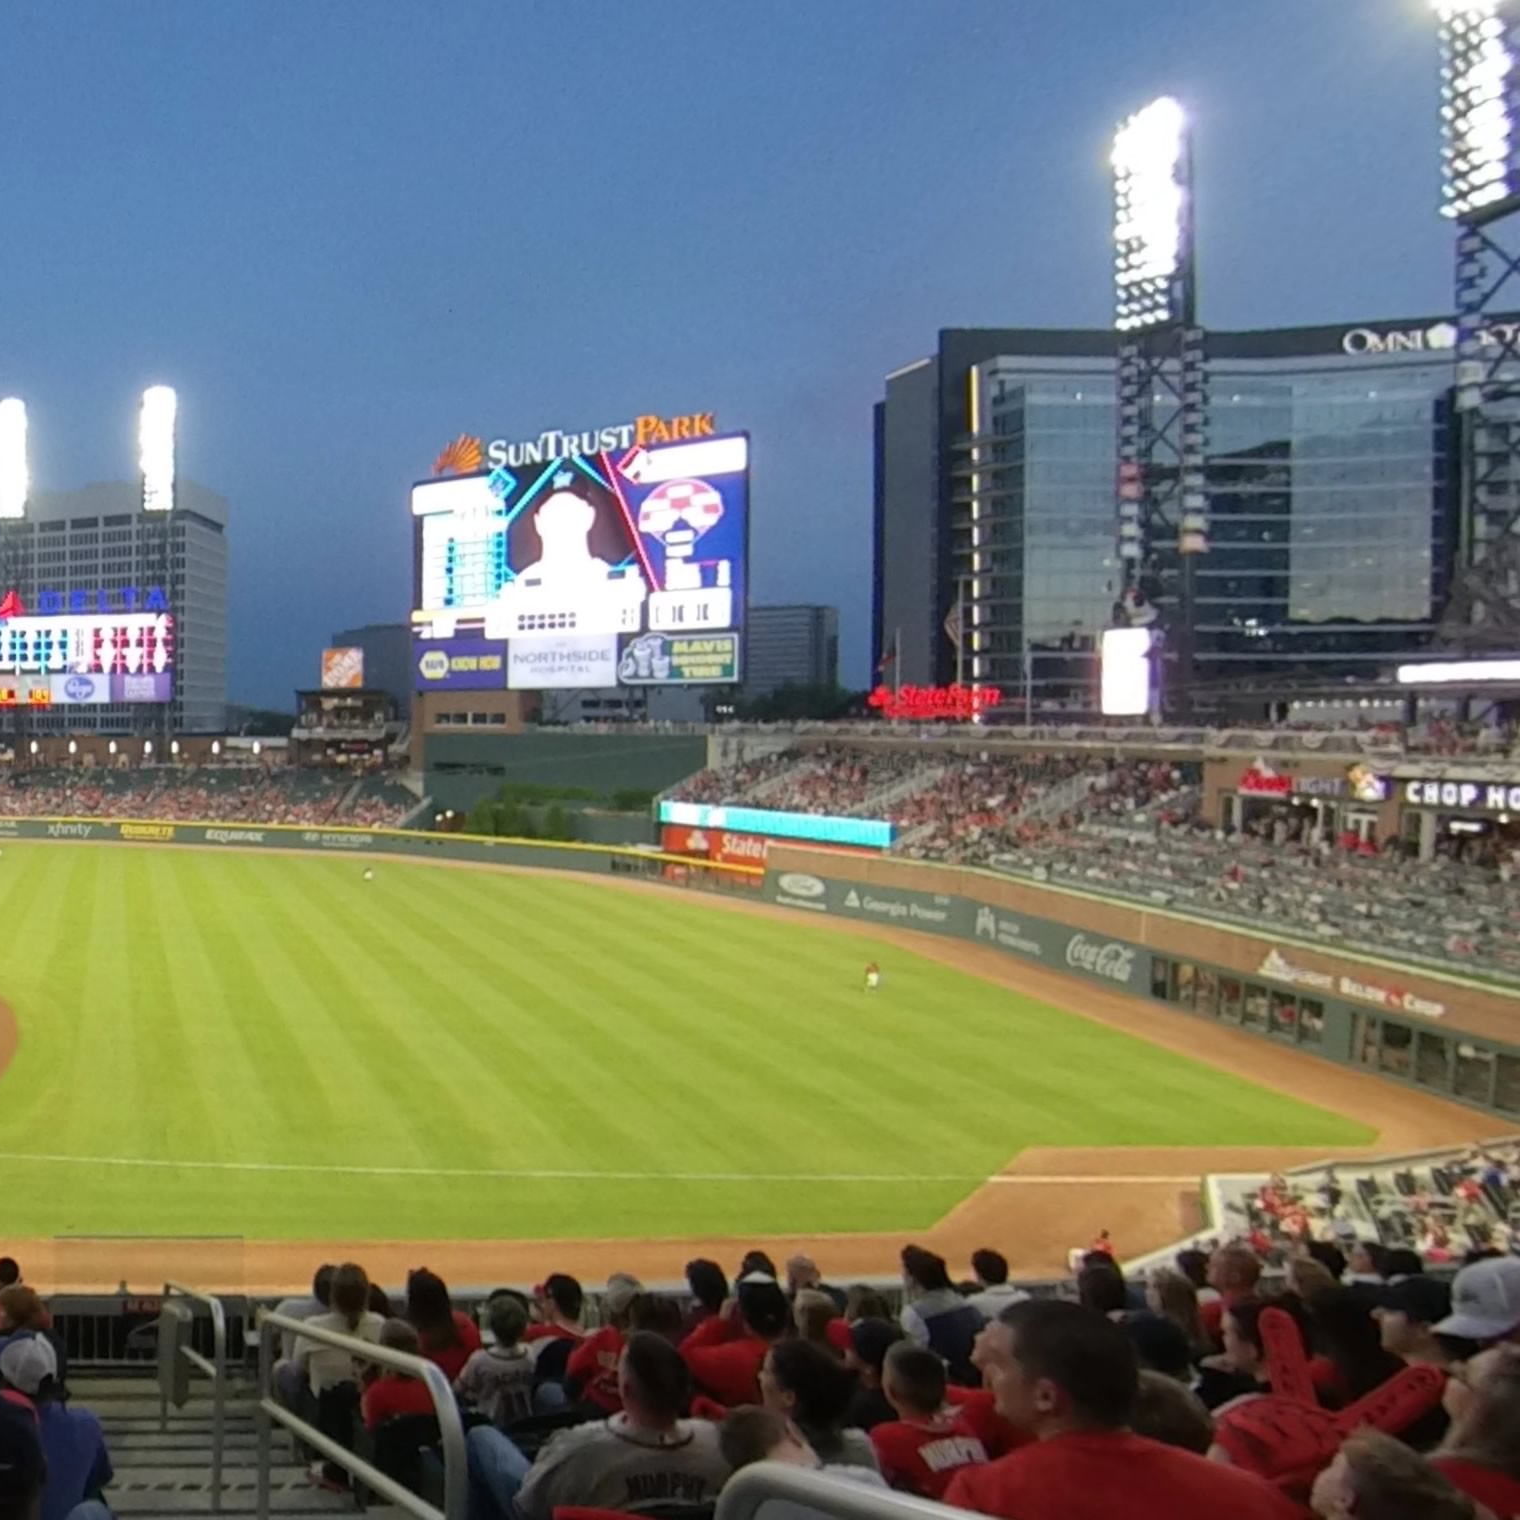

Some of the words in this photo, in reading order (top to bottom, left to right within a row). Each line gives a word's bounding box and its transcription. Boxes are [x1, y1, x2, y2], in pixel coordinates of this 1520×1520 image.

[1342, 328, 1424, 356] OMNI
[635, 412, 713, 445] PARK
[38, 585, 168, 615] DELTA
[512, 649, 612, 665] NORTHSIDE
[529, 665, 592, 675] HOSPITAL
[1405, 780, 1478, 806] CHOP
[47, 822, 92, 839] xfinity
[863, 895, 908, 918] Georgia
[909, 903, 948, 922] Power
[626, 1471, 709, 1502] MURPHY
